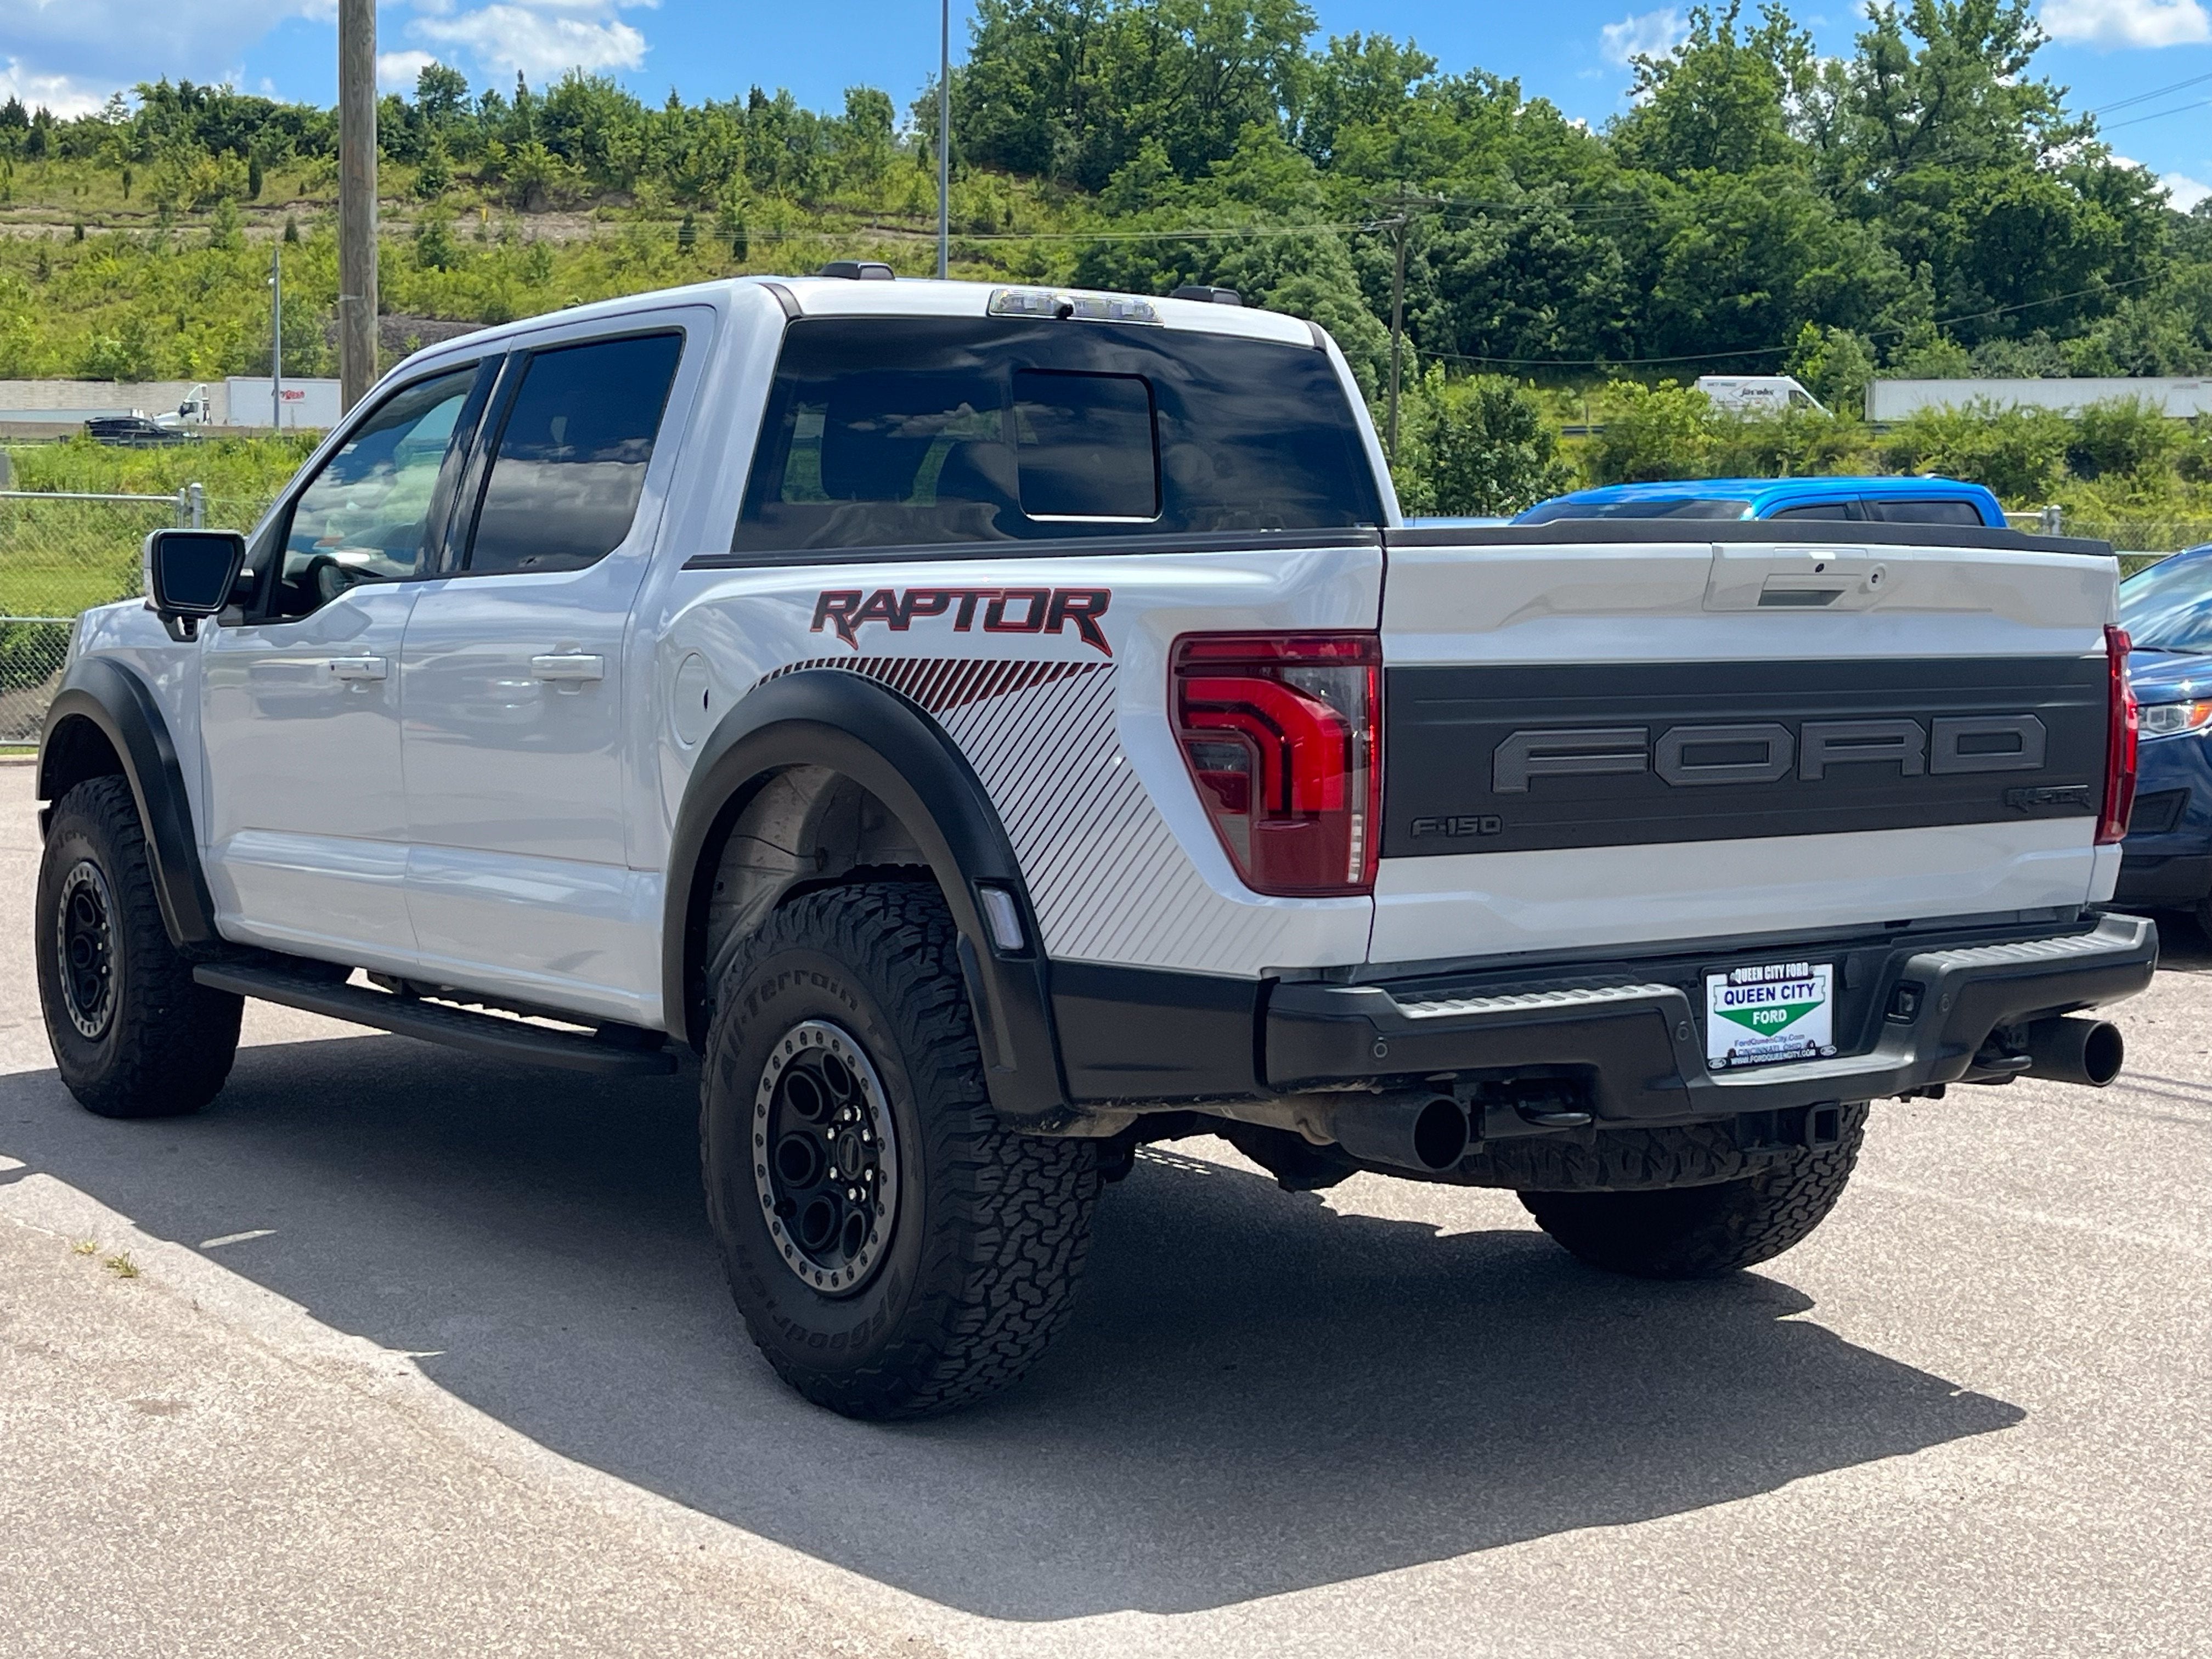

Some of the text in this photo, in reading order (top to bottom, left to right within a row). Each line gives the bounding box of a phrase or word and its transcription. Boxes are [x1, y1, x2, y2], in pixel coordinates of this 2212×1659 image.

[810, 588, 1113, 658] RAPTOR
[1491, 713, 2049, 794] FORD
[1411, 814, 1503, 839] F-150
[1735, 962, 1809, 984] QUEEN CITY FORD
[1724, 983, 1816, 1006] QUEEN CITY
[1753, 1009, 1787, 1025] FORD
